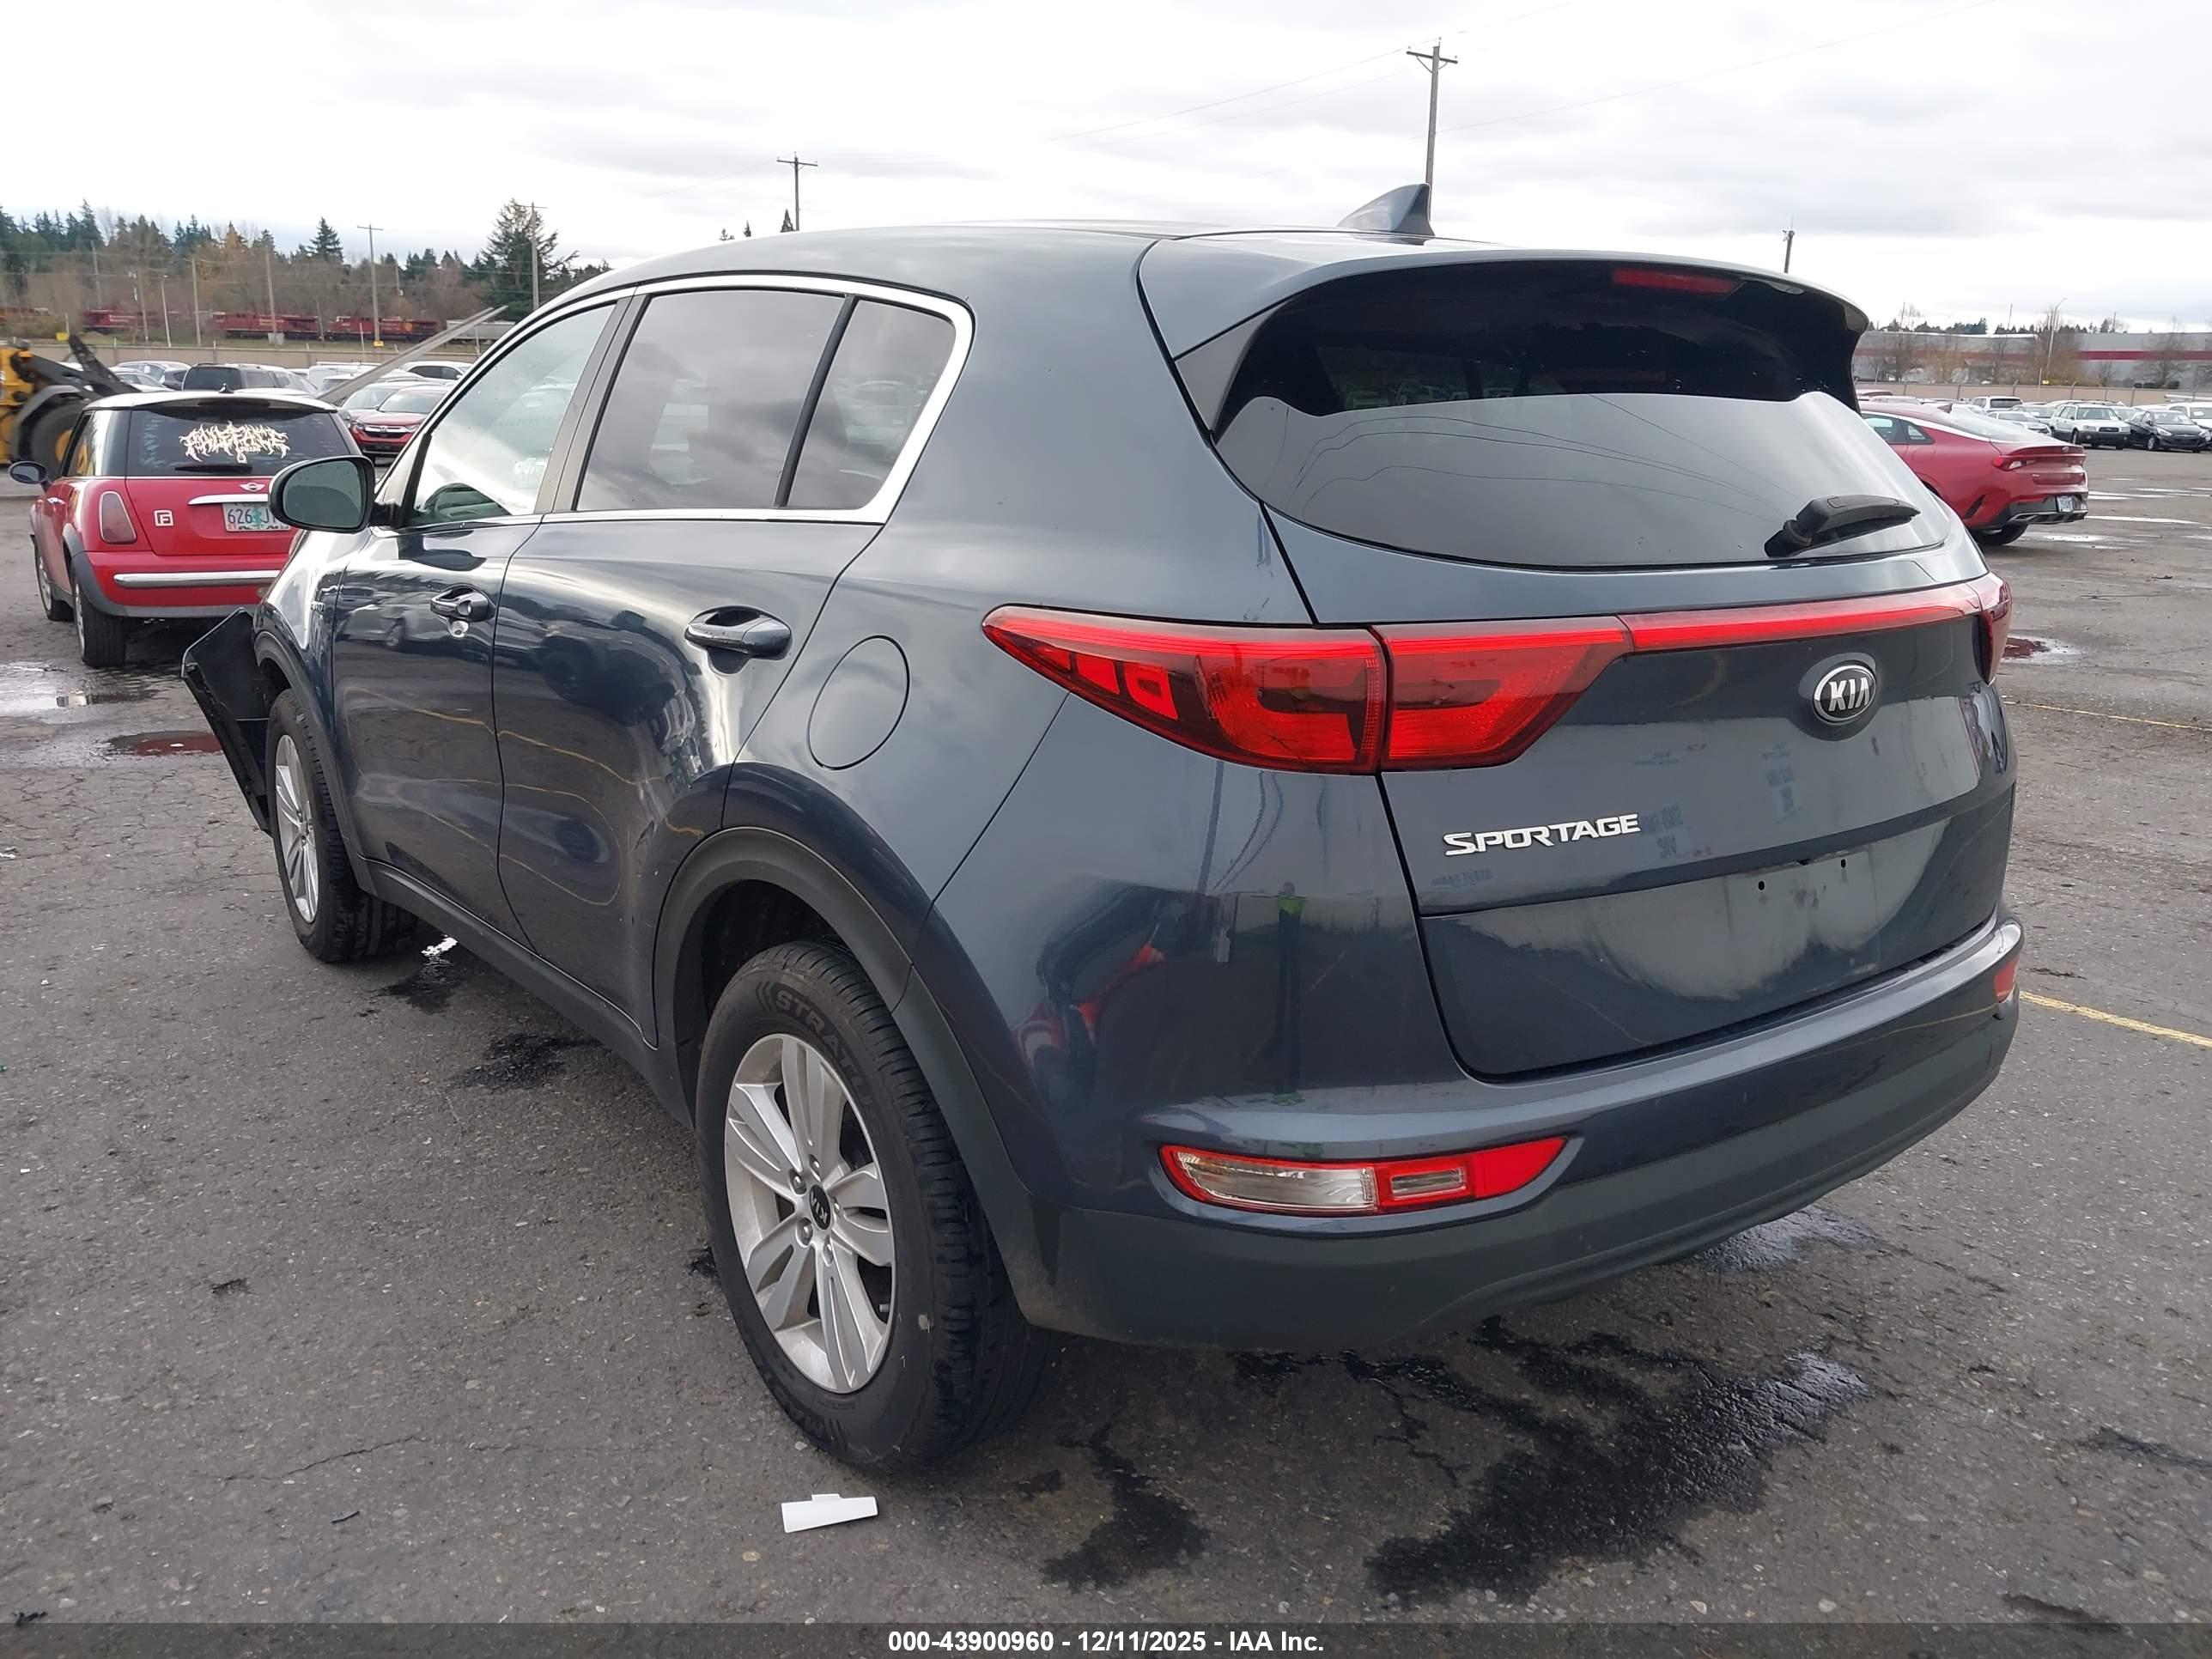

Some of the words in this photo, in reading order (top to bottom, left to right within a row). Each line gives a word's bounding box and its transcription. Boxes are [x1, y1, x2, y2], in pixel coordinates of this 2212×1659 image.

[228, 508, 252, 524] 626
[1828, 677, 1870, 712] KIA
[1443, 814, 1641, 856] SPORTAGE
